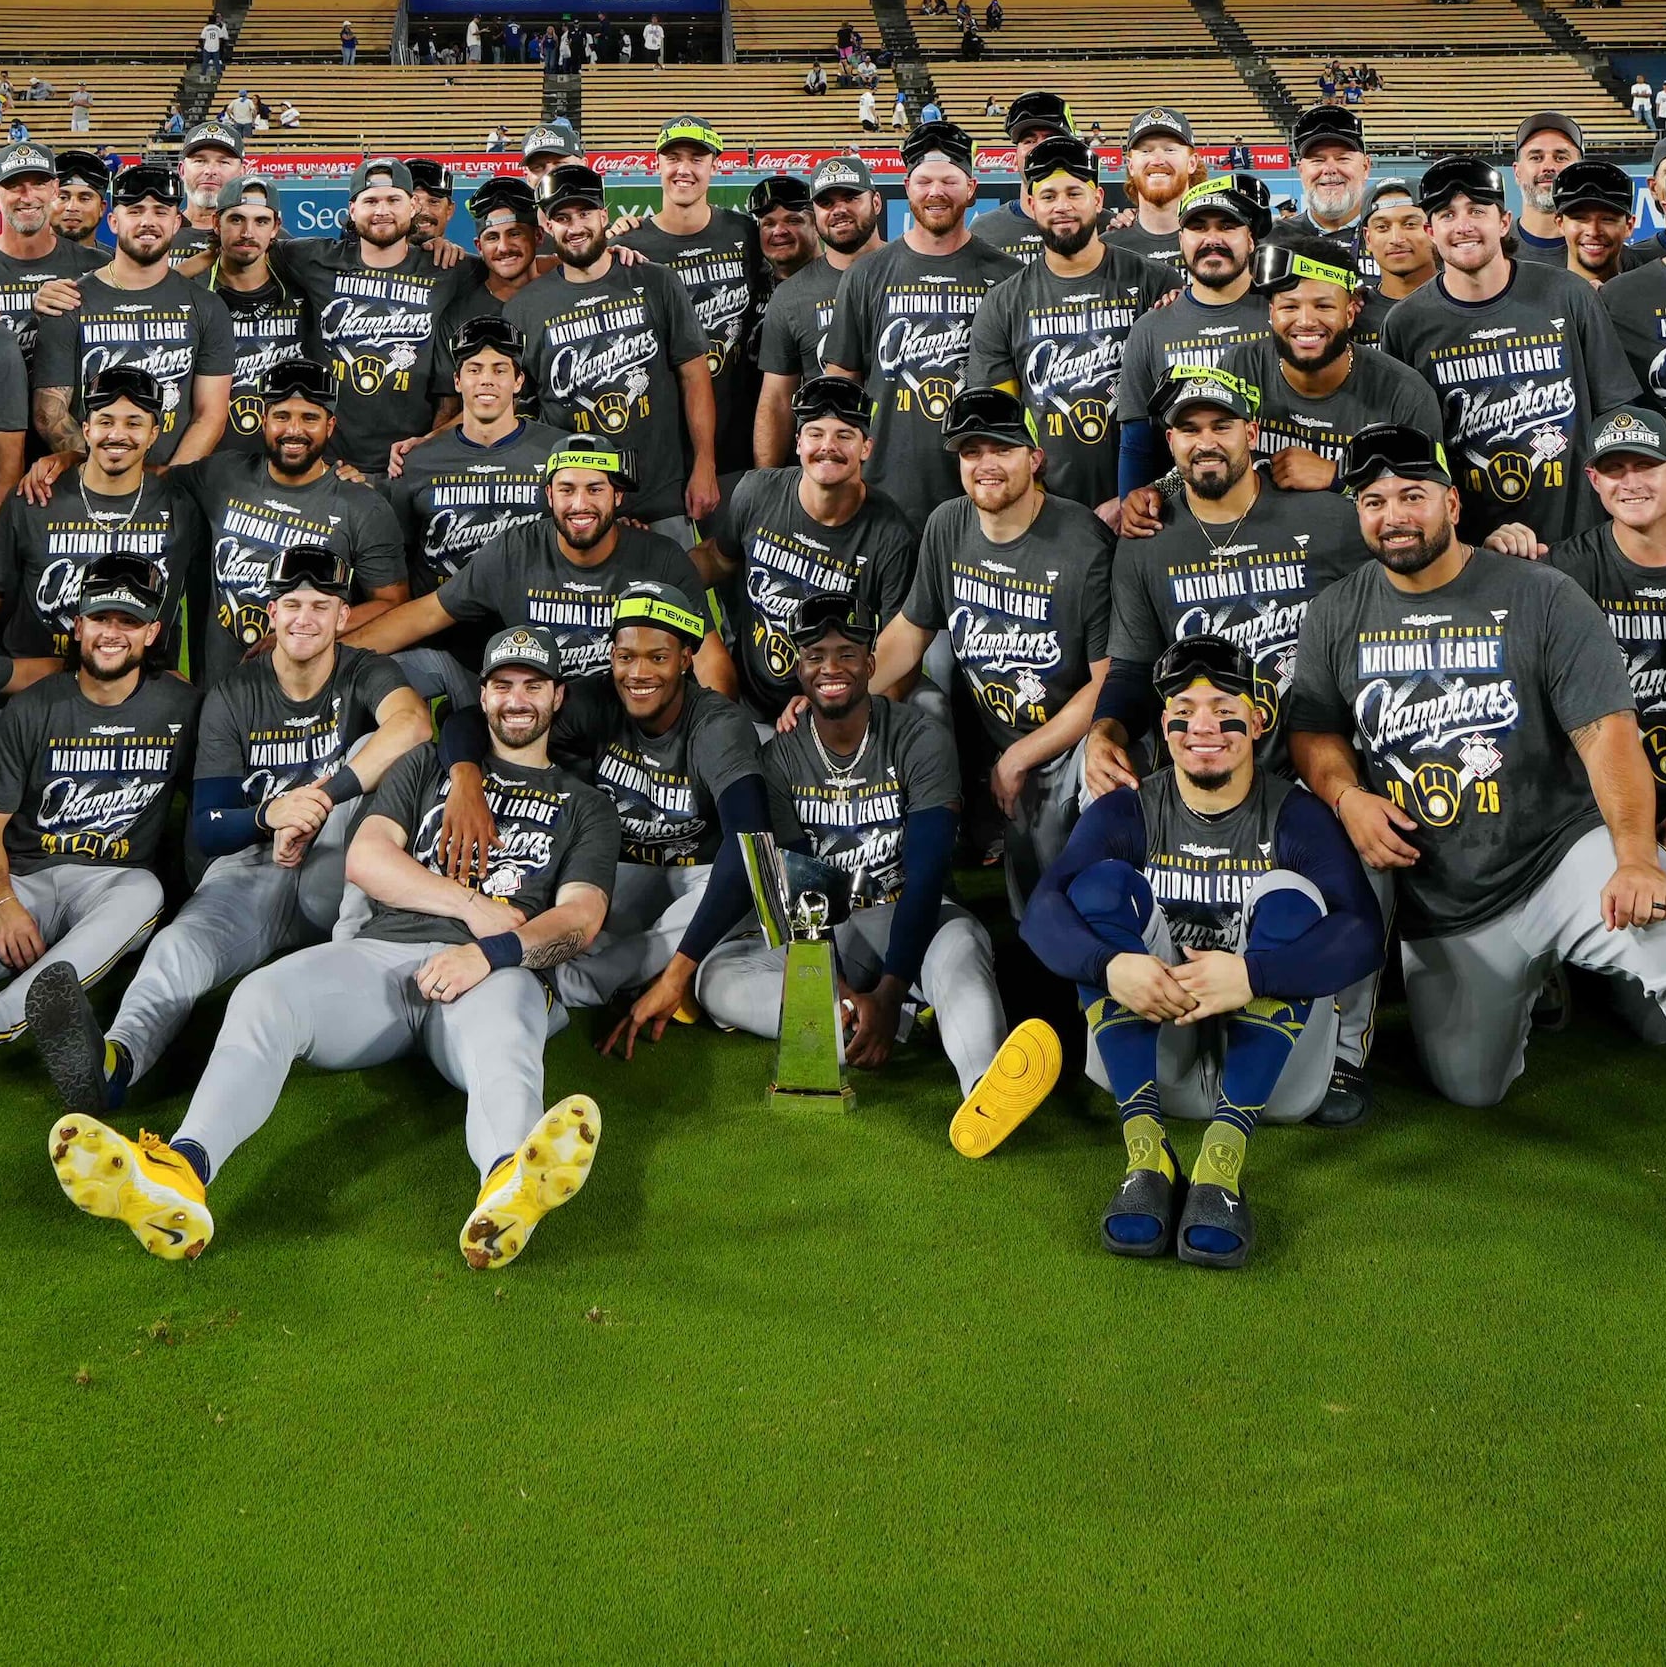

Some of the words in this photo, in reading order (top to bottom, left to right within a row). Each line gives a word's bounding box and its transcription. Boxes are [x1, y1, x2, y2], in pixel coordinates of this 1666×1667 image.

[1, 160, 25, 172] WORLD
[26, 158, 50, 169] SERIES
[261, 163, 293, 173] HOME
[296, 163, 318, 172] RUN
[465, 162, 502, 172] EVERY
[1258, 155, 1284, 165] TIME
[549, 317, 602, 346] NATIONAL
[604, 306, 645, 334] LEAGUE
[550, 328, 659, 399] Champions
[1435, 352, 1505, 385] NATIONAL
[1508, 346, 1563, 375] LEAGUE
[1443, 375, 1577, 447] Champions
[1594, 430, 1631, 452] WORLD
[1632, 429, 1661, 446] SERIES
[1543, 460, 1564, 488] 26
[953, 575, 1007, 609] NATIONAL
[1008, 586, 1051, 620] LEAGUE
[948, 605, 1062, 672] Champions
[1358, 628, 1433, 643] MILWAUKEE
[1440, 625, 1503, 638] BREWERS
[490, 648, 517, 663] WORLD
[518, 648, 549, 664] SERIES
[1361, 645, 1435, 673] NATIONAL
[1439, 642, 1499, 669] LEAGUE
[1354, 676, 1519, 754] Champions
[51, 749, 118, 772] NATIONAL
[120, 748, 170, 771] LEAGUE
[1476, 781, 1500, 814] 26
